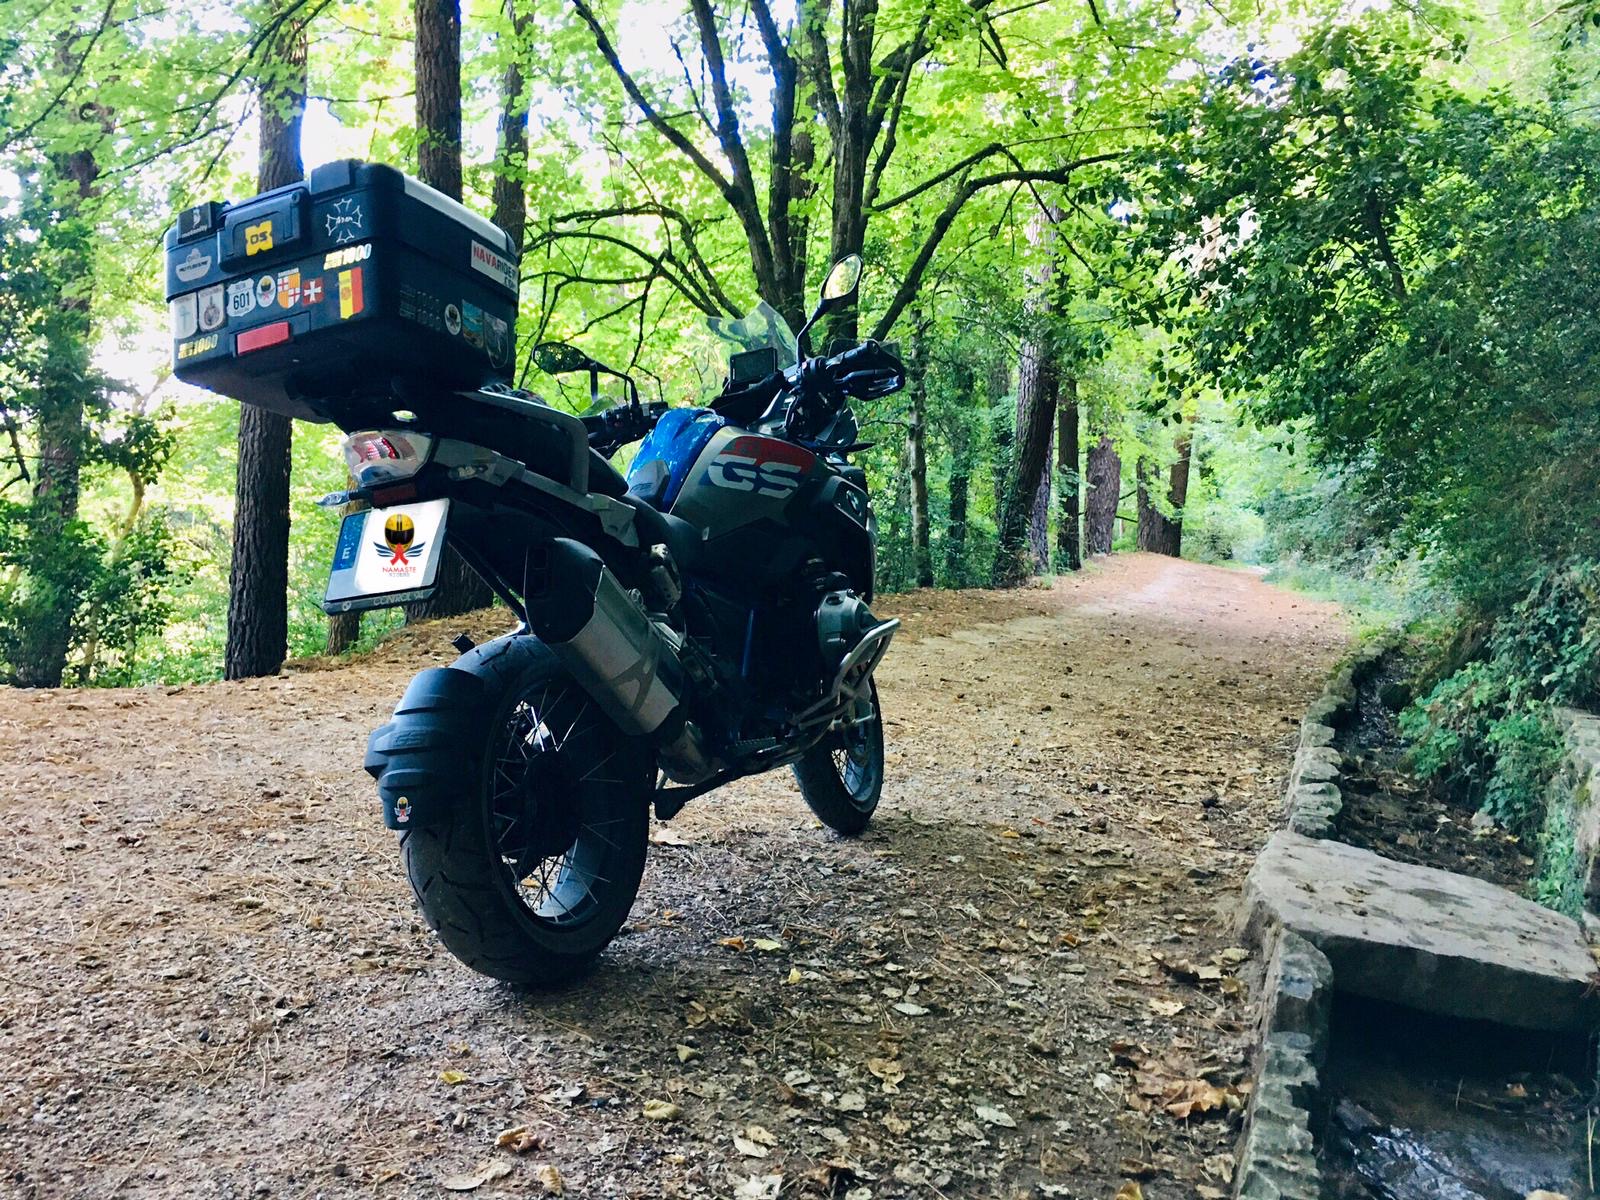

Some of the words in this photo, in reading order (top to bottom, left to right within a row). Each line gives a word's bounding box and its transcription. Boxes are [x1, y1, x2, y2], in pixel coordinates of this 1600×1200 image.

[232, 293, 251, 311] 601
[707, 453, 802, 499] GS
[341, 547, 351, 560] E
